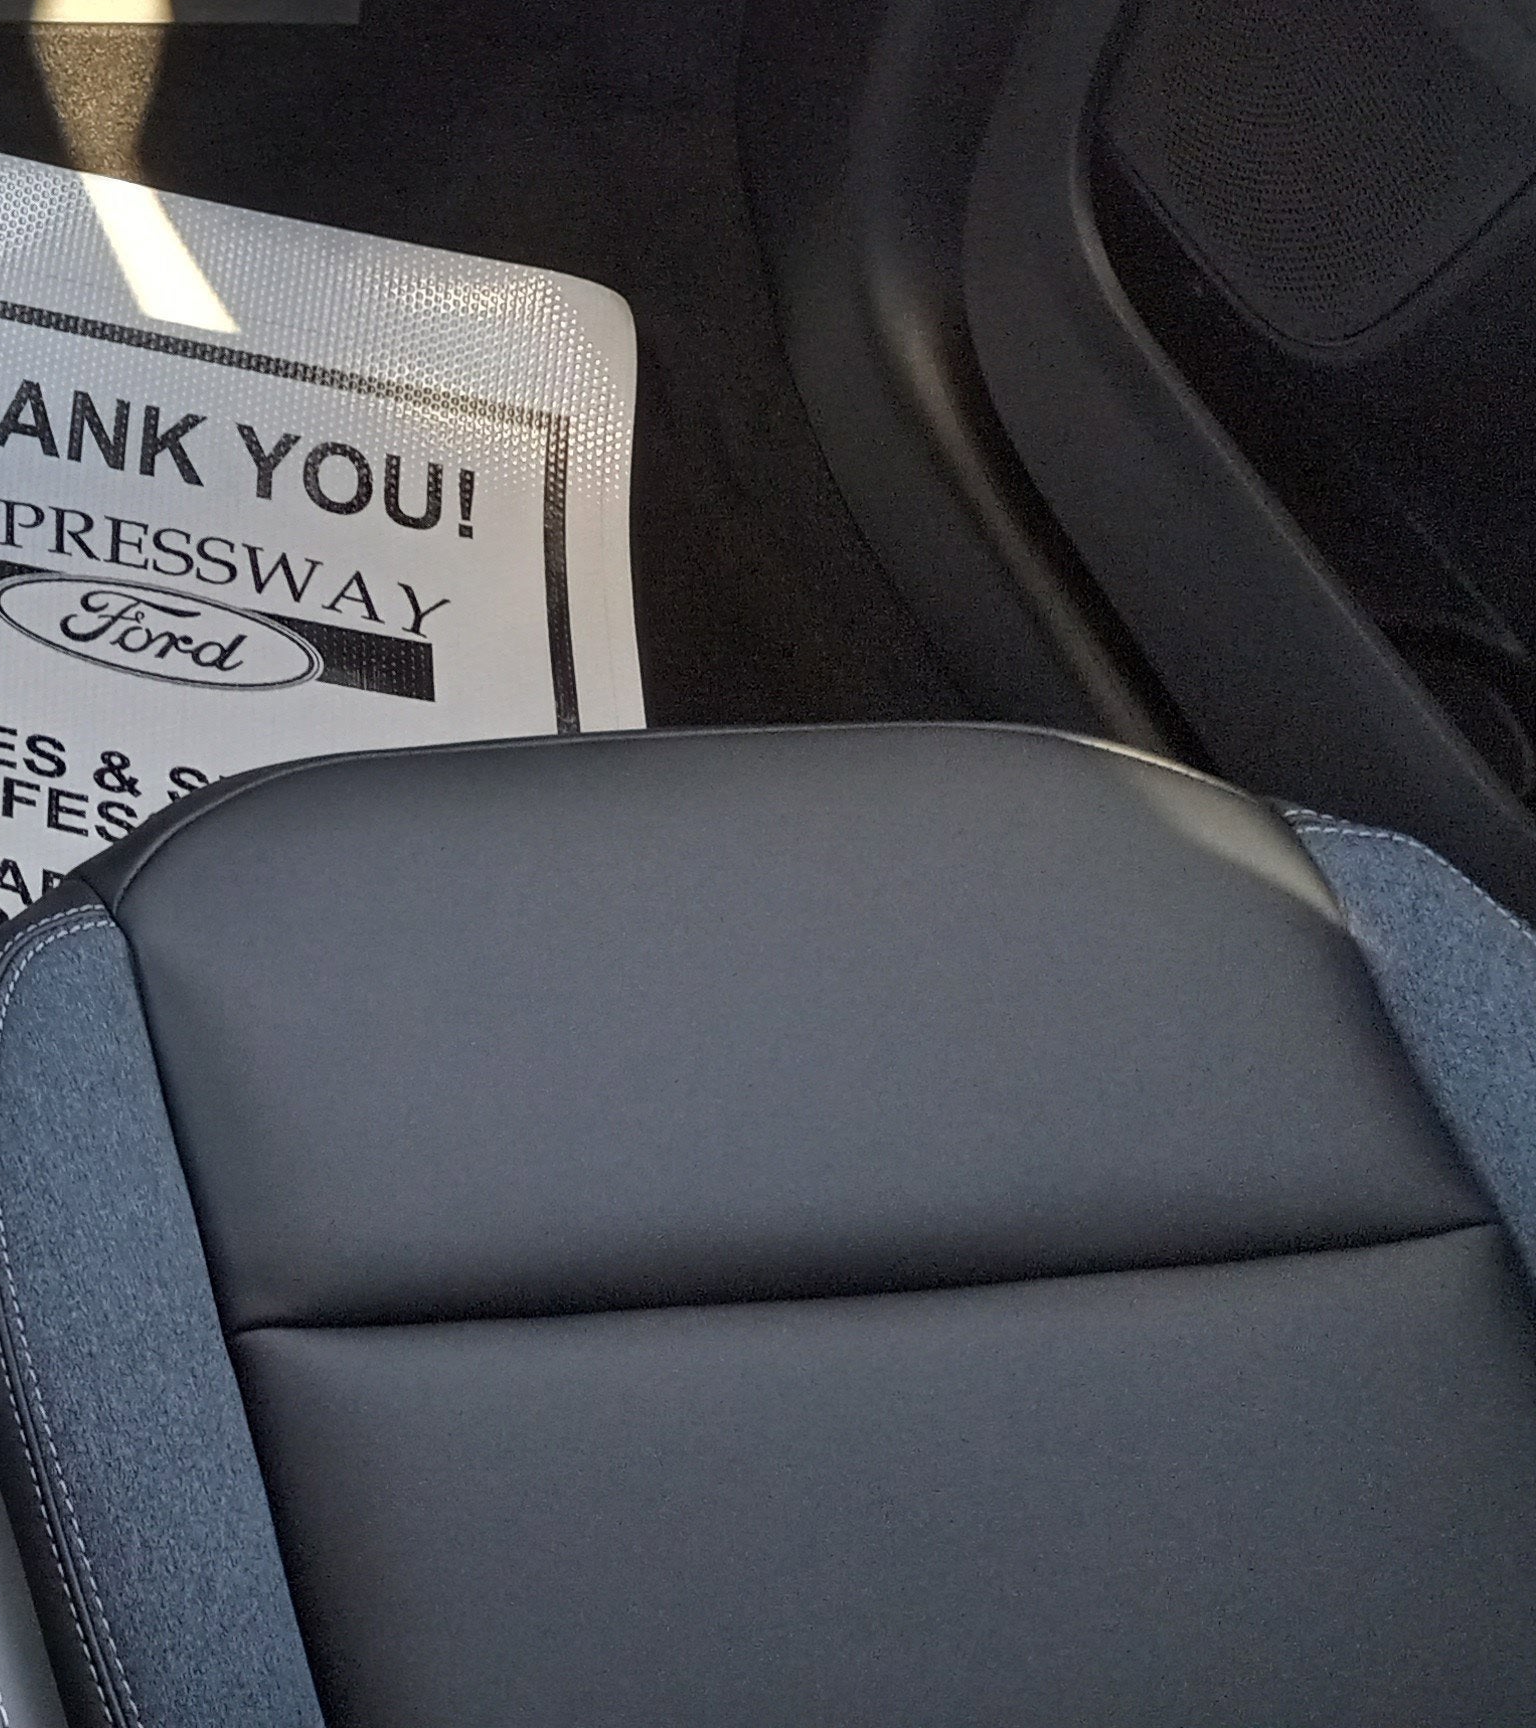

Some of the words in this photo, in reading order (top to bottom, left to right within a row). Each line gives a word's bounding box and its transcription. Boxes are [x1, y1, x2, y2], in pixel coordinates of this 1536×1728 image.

[235, 421, 477, 540] YOU!
[59, 589, 246, 673] Ford
[93, 751, 142, 798] &
